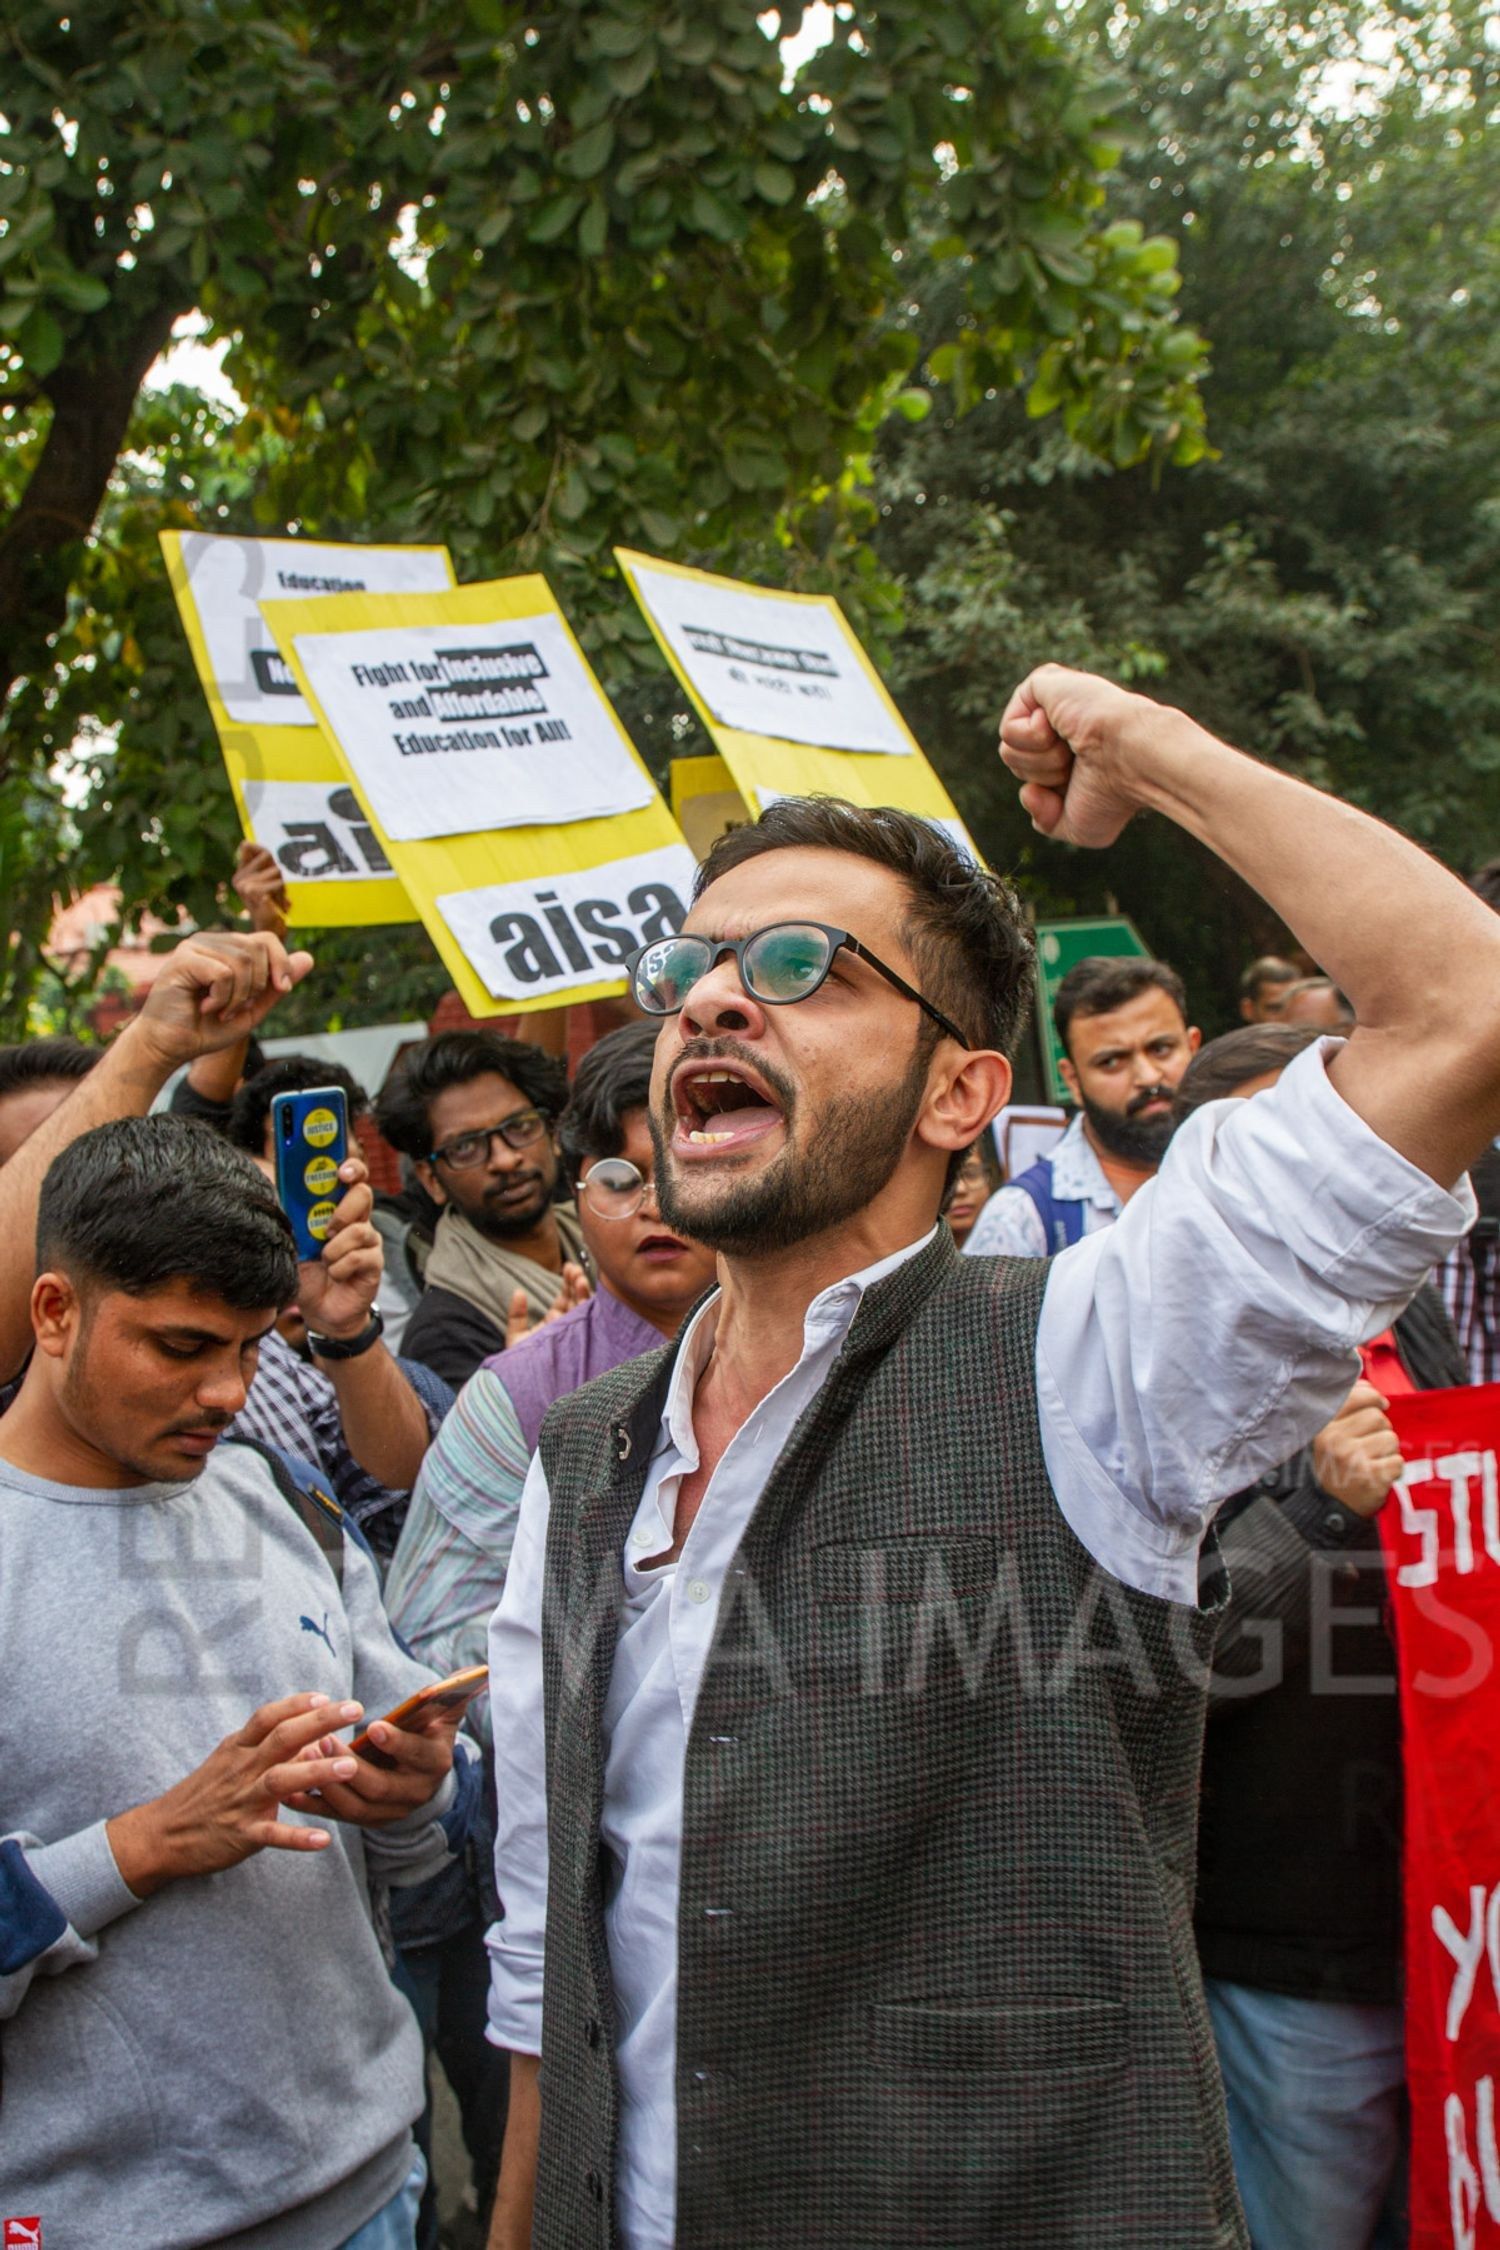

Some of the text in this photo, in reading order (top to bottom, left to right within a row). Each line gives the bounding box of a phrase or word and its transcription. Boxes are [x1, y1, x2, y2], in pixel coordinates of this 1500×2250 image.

[351, 652, 545, 688] Fight for Inclusive
[389, 687, 545, 719] and Affordable
[393, 718, 572, 756] Education for All!
[490, 882, 688, 983] aisa
